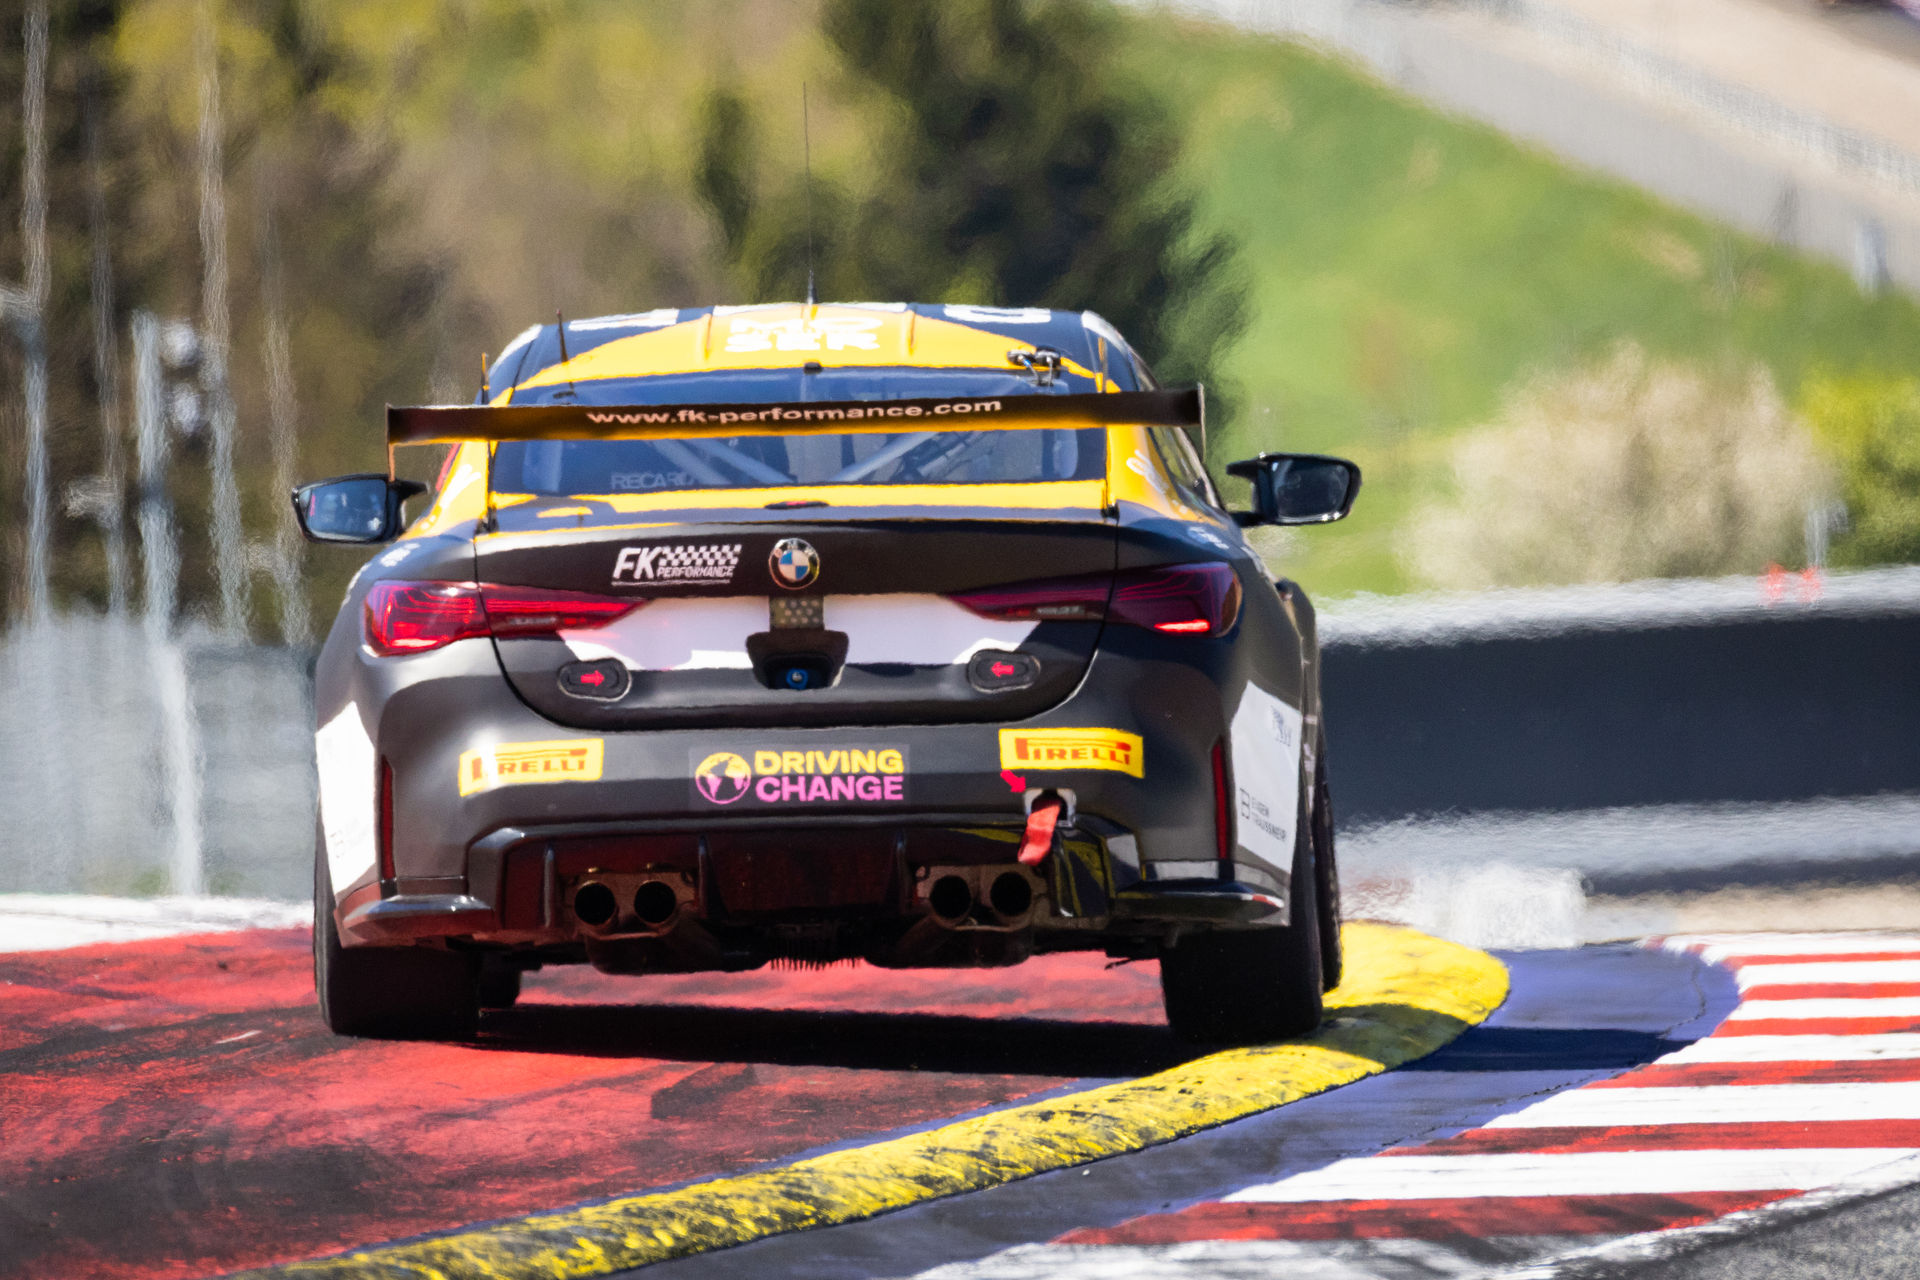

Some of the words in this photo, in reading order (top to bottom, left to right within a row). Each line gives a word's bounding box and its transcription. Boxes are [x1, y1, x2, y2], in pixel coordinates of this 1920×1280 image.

[587, 399, 1002, 425] www.fk-performance.com
[612, 546, 662, 580] FK
[657, 565, 736, 579] PERFORMANCE
[471, 748, 588, 781] PRELLI
[755, 749, 905, 775] DRIVING
[1015, 737, 1132, 766] PIRELLI
[755, 775, 905, 803] CHANGE
